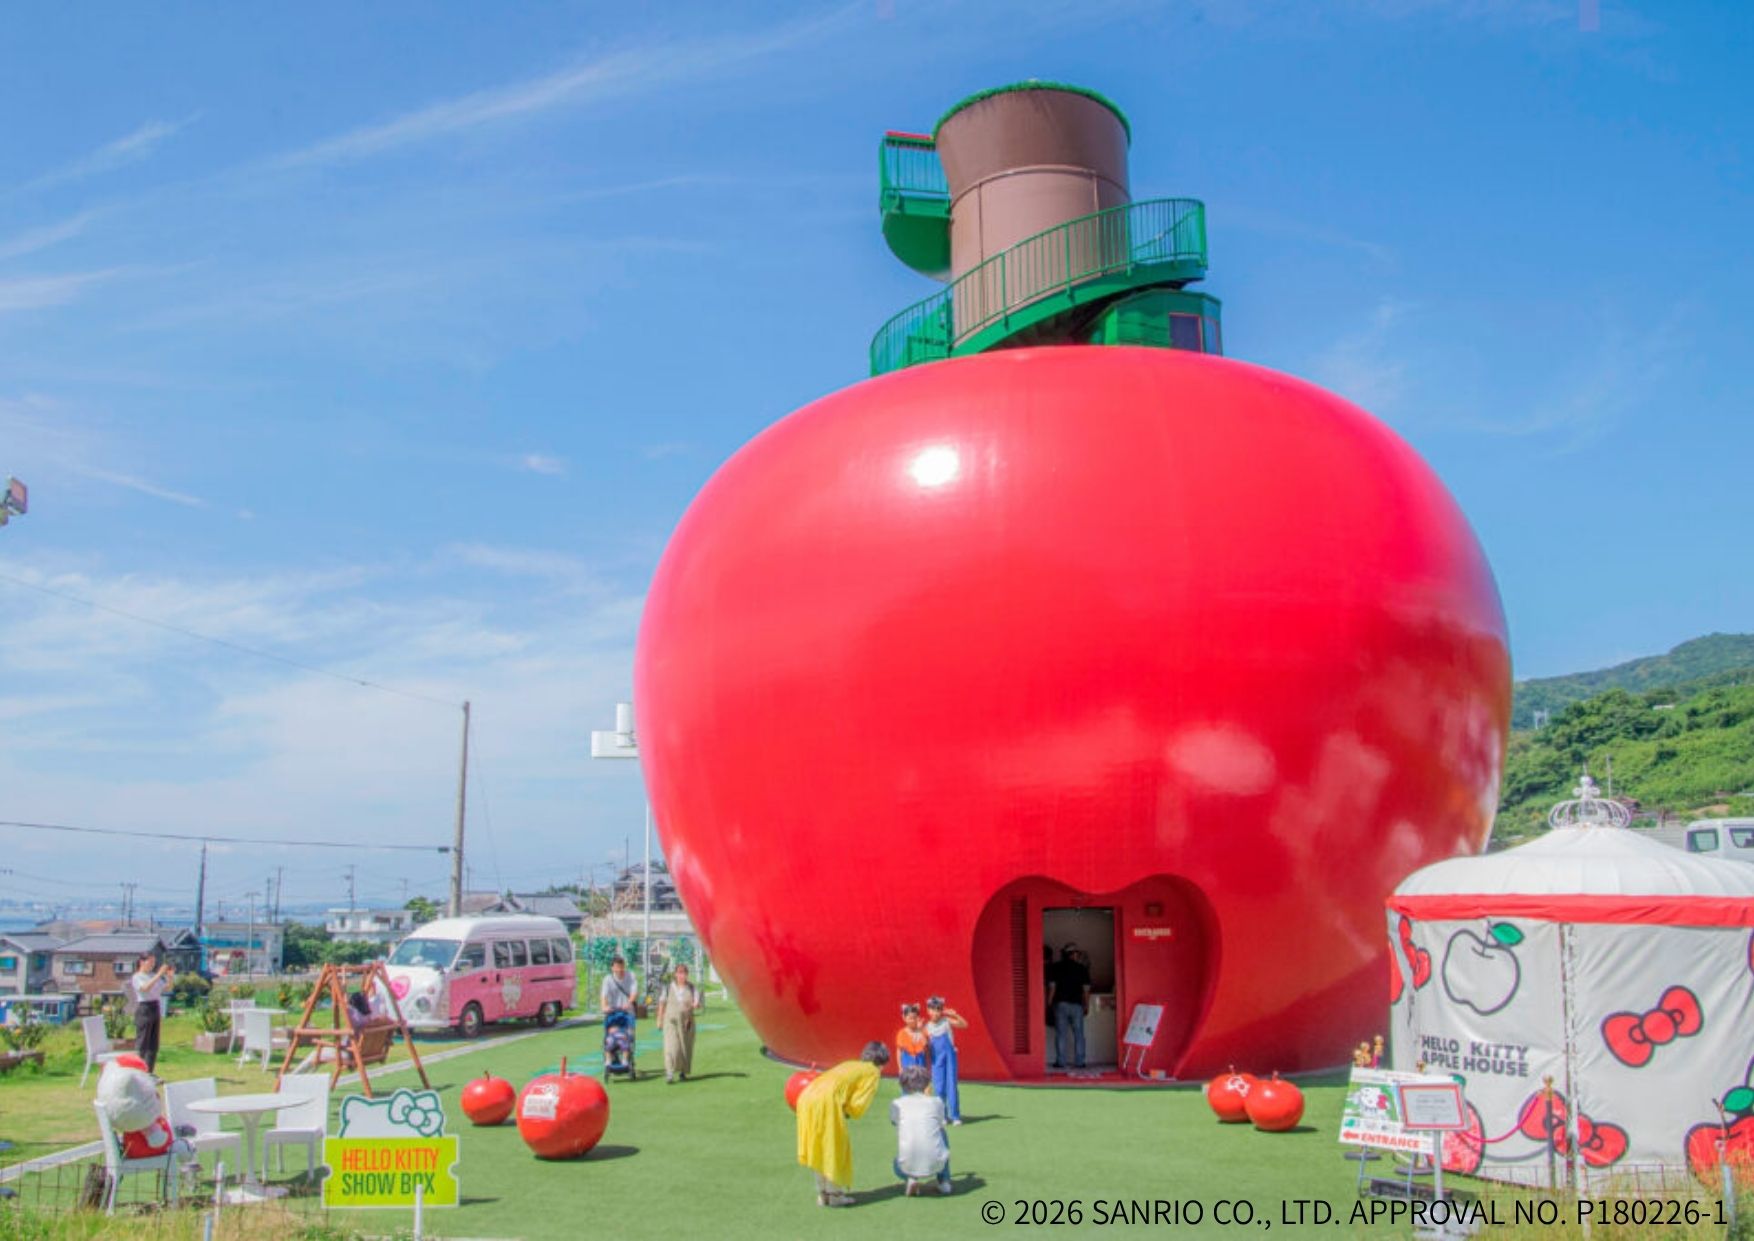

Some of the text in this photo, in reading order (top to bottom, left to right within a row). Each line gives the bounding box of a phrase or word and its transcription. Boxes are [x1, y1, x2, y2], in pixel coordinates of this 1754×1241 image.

[1421, 1035, 1529, 1060] HELLO KITTY
[1421, 1050, 1529, 1077] APPLE HOUSE
[1361, 1132, 1420, 1149] ENTRANCE
[341, 1148, 440, 1171] HELLO KITTY
[341, 1172, 395, 1195] SHOW
